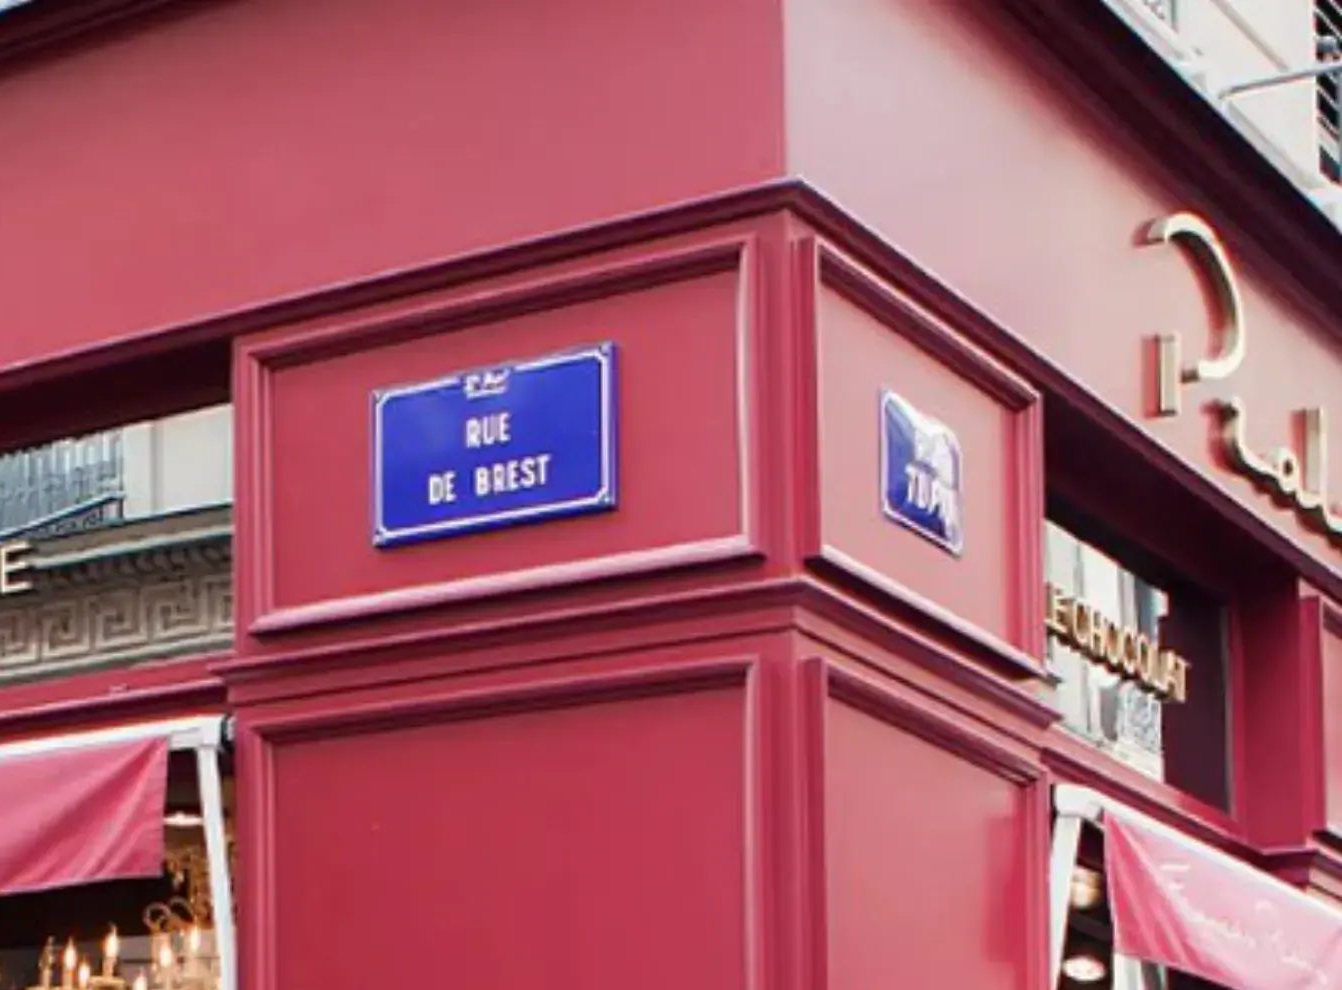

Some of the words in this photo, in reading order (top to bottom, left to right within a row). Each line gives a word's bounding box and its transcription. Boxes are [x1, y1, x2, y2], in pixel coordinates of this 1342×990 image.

[465, 412, 511, 449] RUE
[428, 472, 456, 505] DE
[474, 453, 552, 497] BREST
